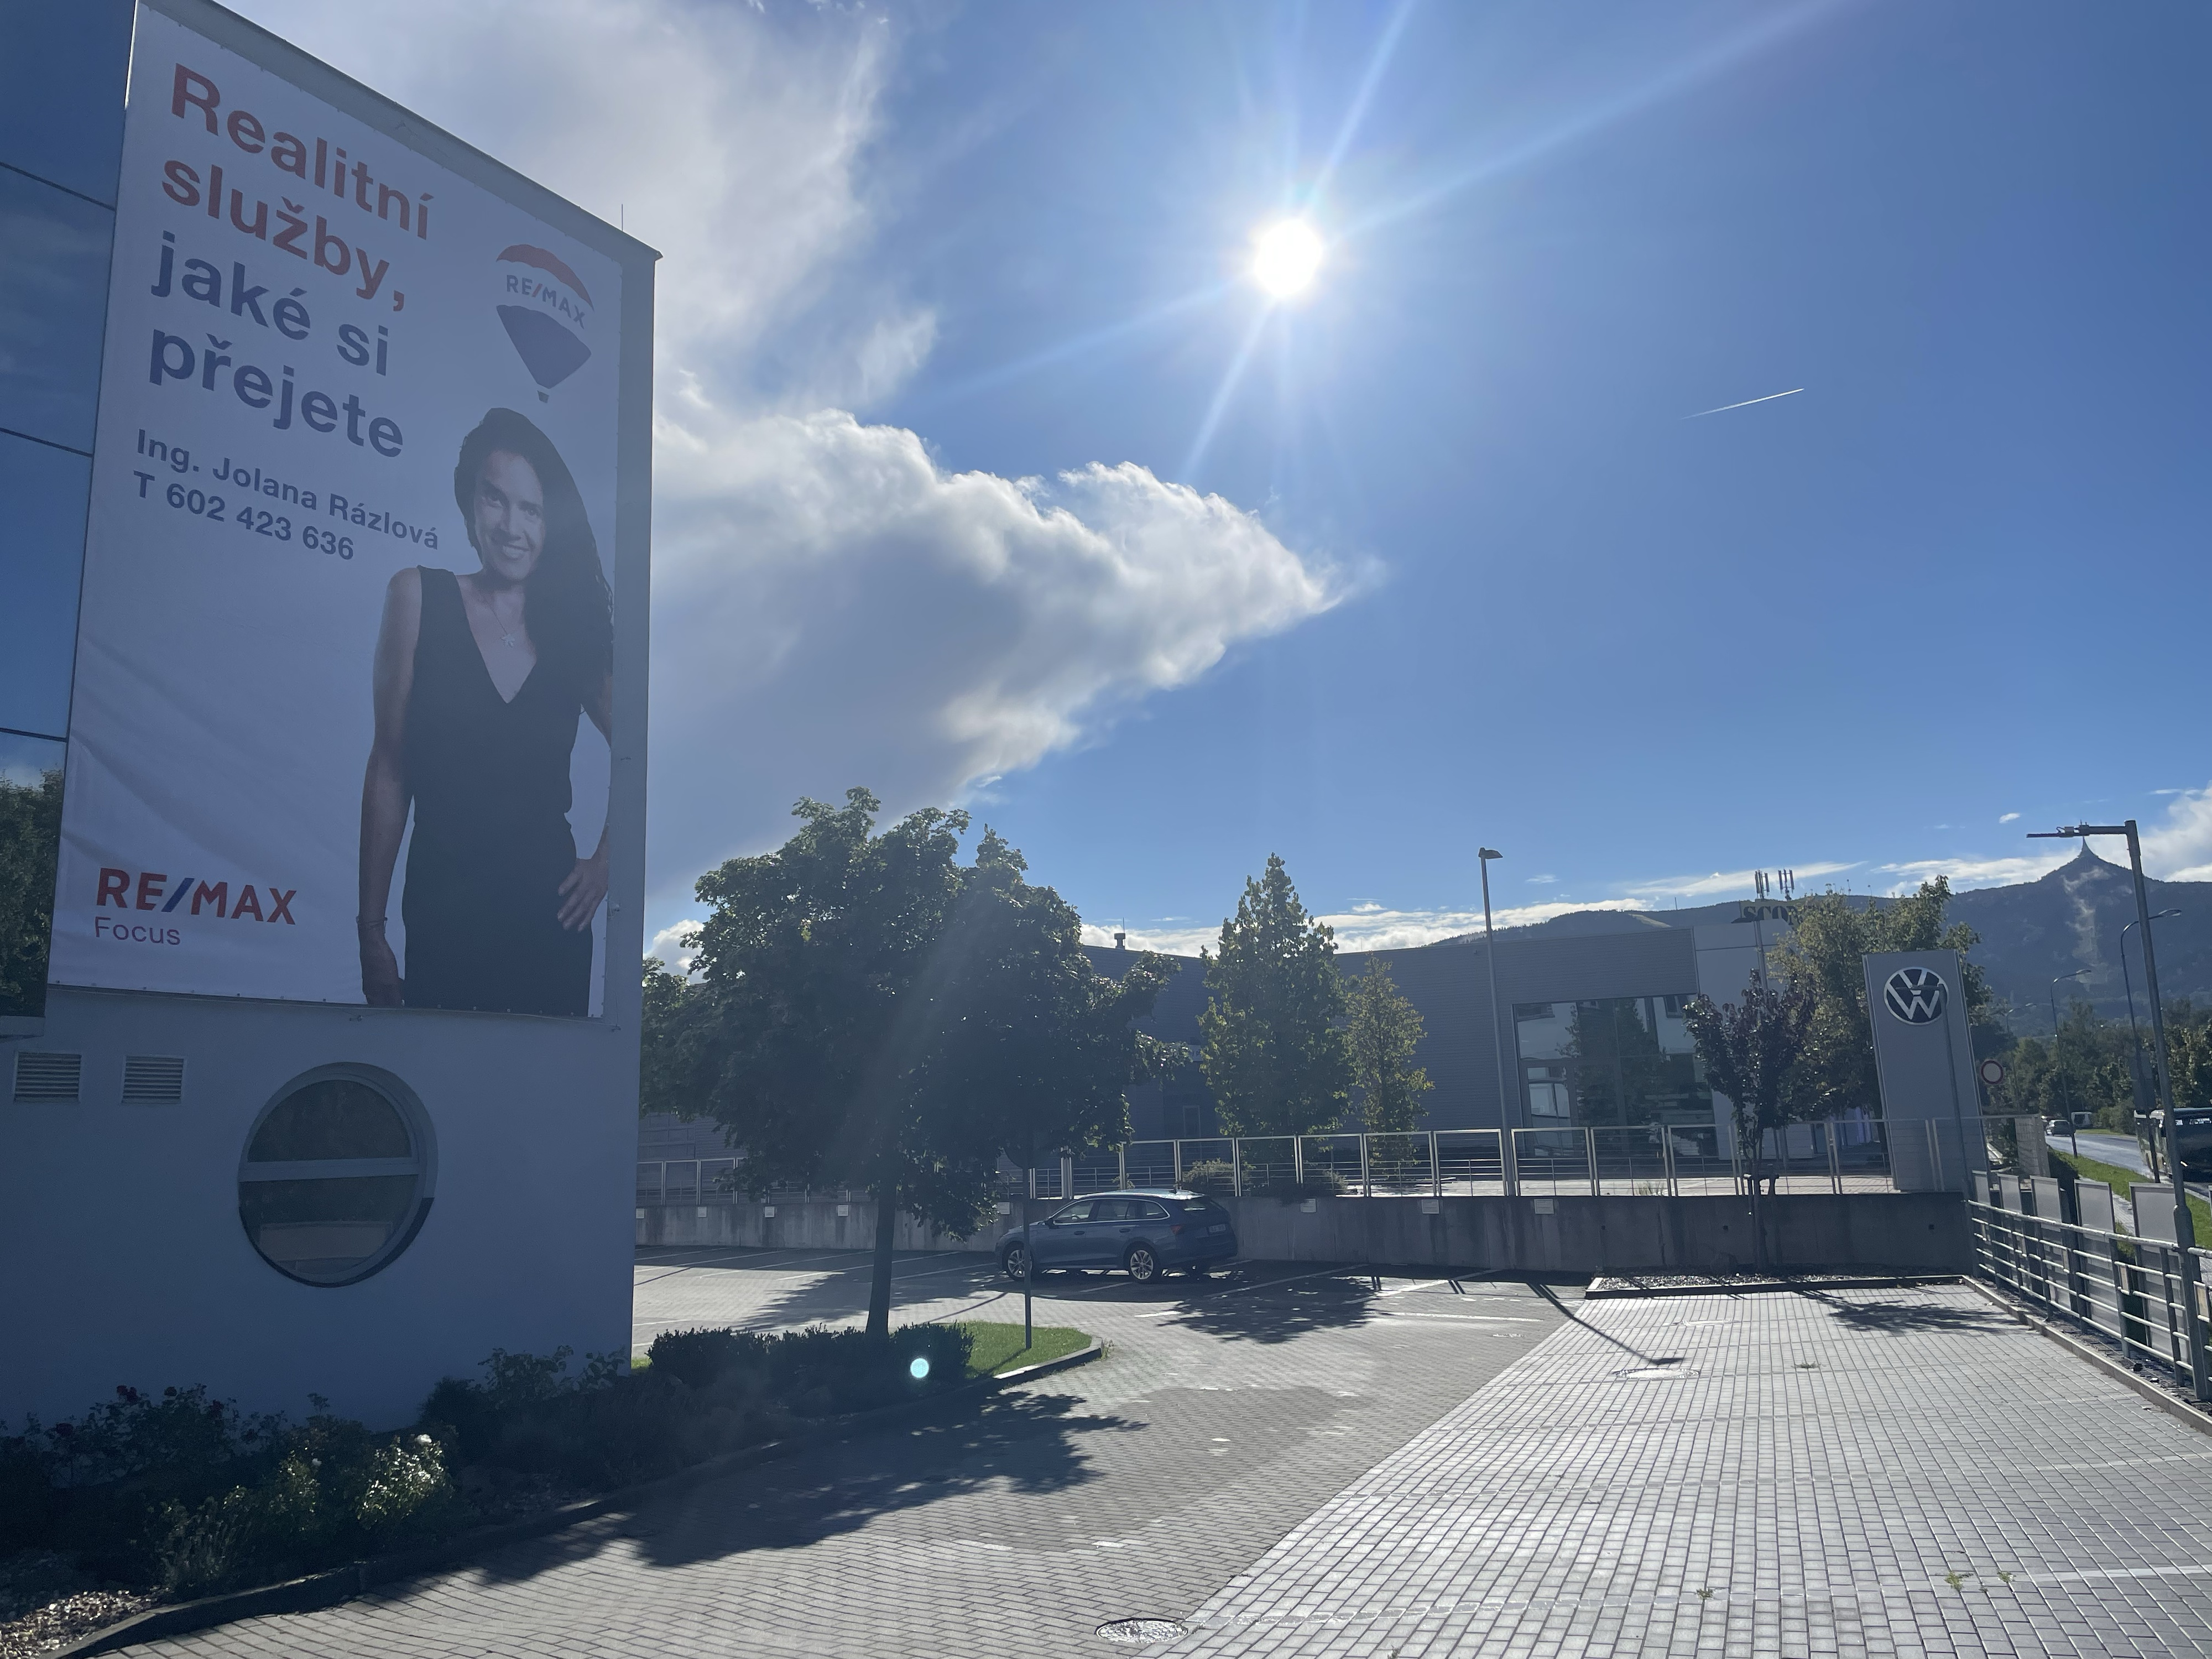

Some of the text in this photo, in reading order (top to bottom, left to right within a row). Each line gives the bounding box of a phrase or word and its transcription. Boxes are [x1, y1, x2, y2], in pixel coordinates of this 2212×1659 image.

[171, 62, 435, 240] Realitní
[161, 160, 405, 311] služby,
[150, 230, 389, 377] jaké si
[507, 274, 585, 330] RE/MAX
[149, 329, 403, 458] přejete
[133, 470, 354, 560] T 602 423 636
[137, 429, 438, 550] Ing. Jolana Rázlová
[95, 916, 181, 946] Focus
[96, 867, 298, 925] RE/MAX
[1885, 968, 1946, 1021] VW
